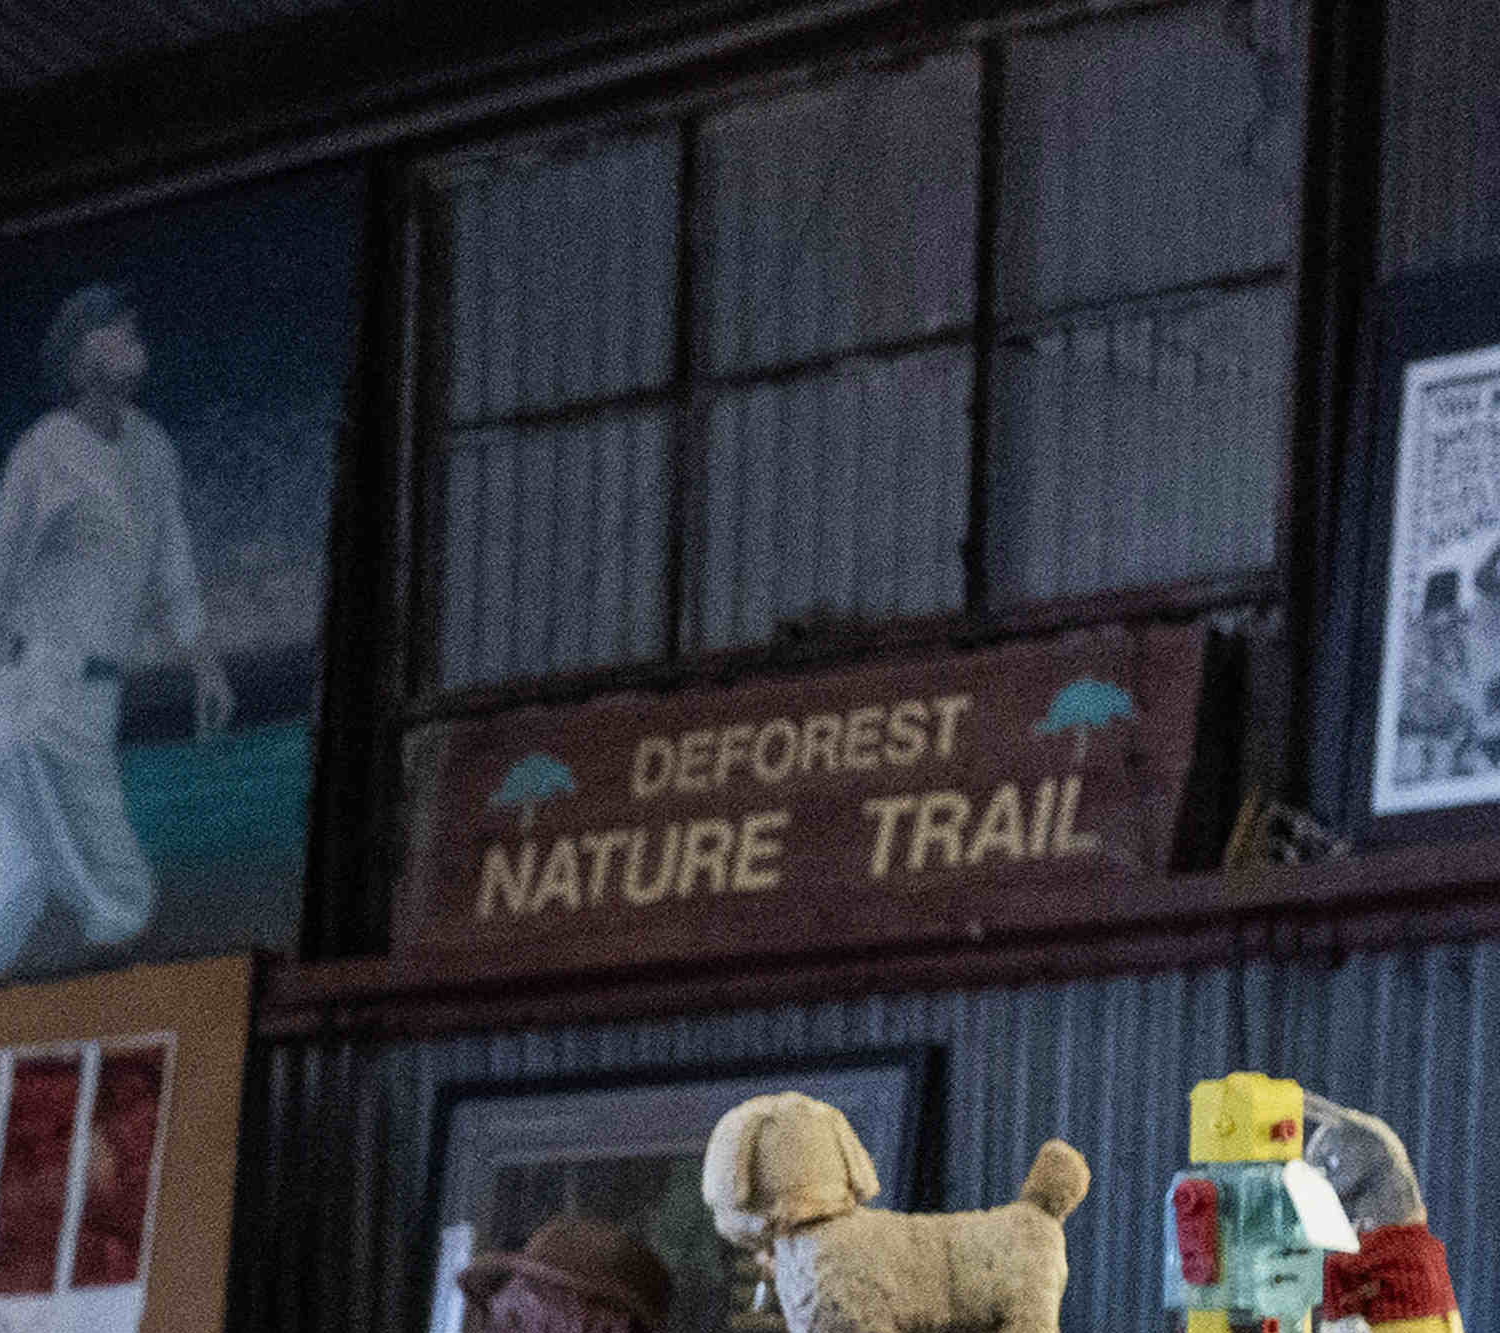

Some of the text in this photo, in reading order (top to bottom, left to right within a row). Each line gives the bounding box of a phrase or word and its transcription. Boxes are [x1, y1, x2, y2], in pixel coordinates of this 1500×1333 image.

[632, 696, 972, 800] DEFOREST
[478, 777, 1098, 920] NATURE TRAIL
